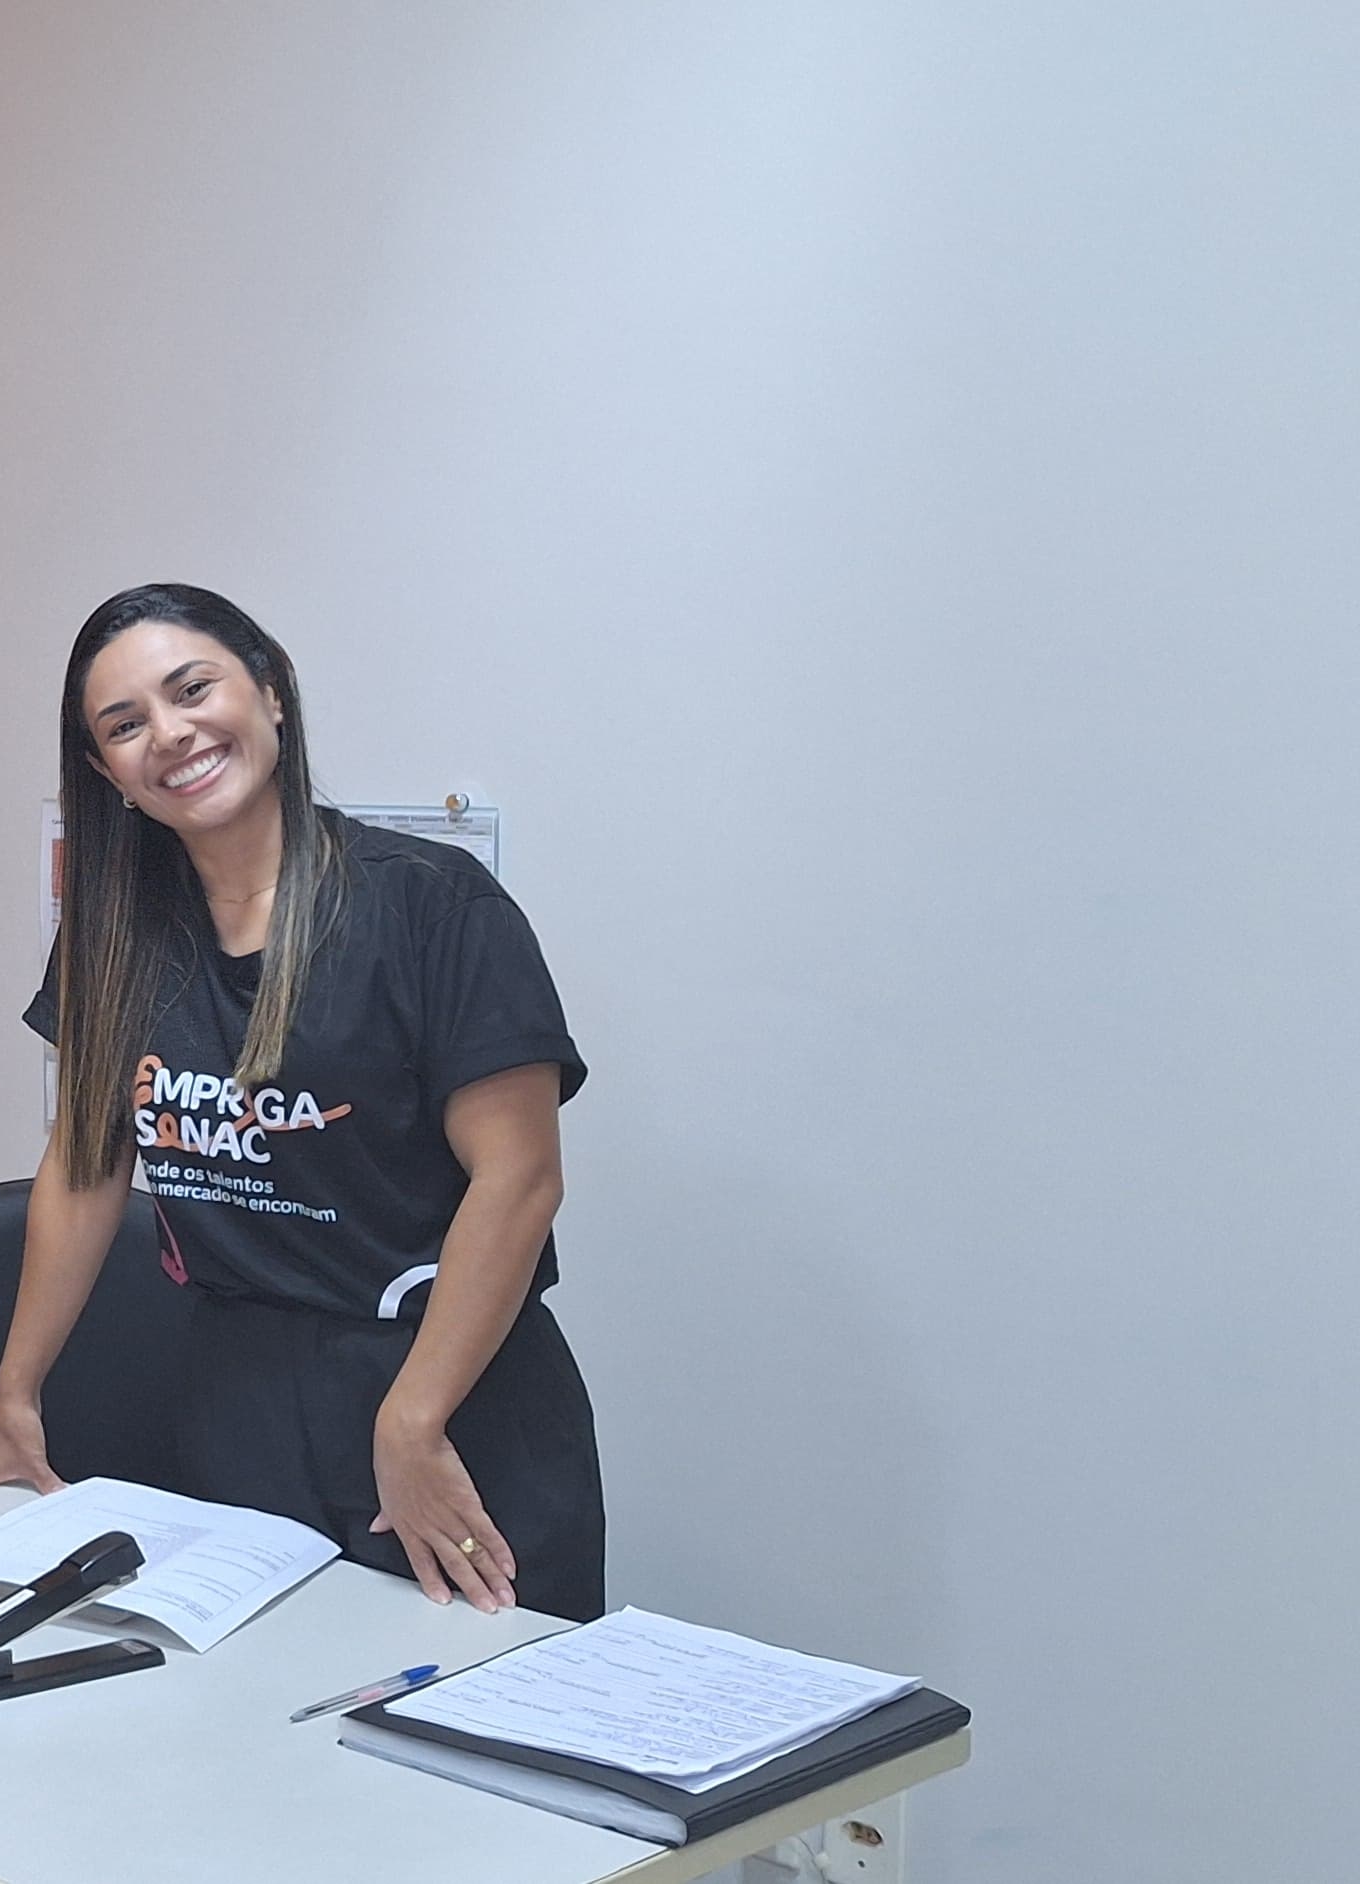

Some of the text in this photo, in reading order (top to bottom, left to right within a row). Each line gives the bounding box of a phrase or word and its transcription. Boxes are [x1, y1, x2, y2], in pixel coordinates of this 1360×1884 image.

[158, 1182, 231, 1203] mercado
[183, 1167, 205, 1182] os
[206, 1168, 274, 1194] talentos
